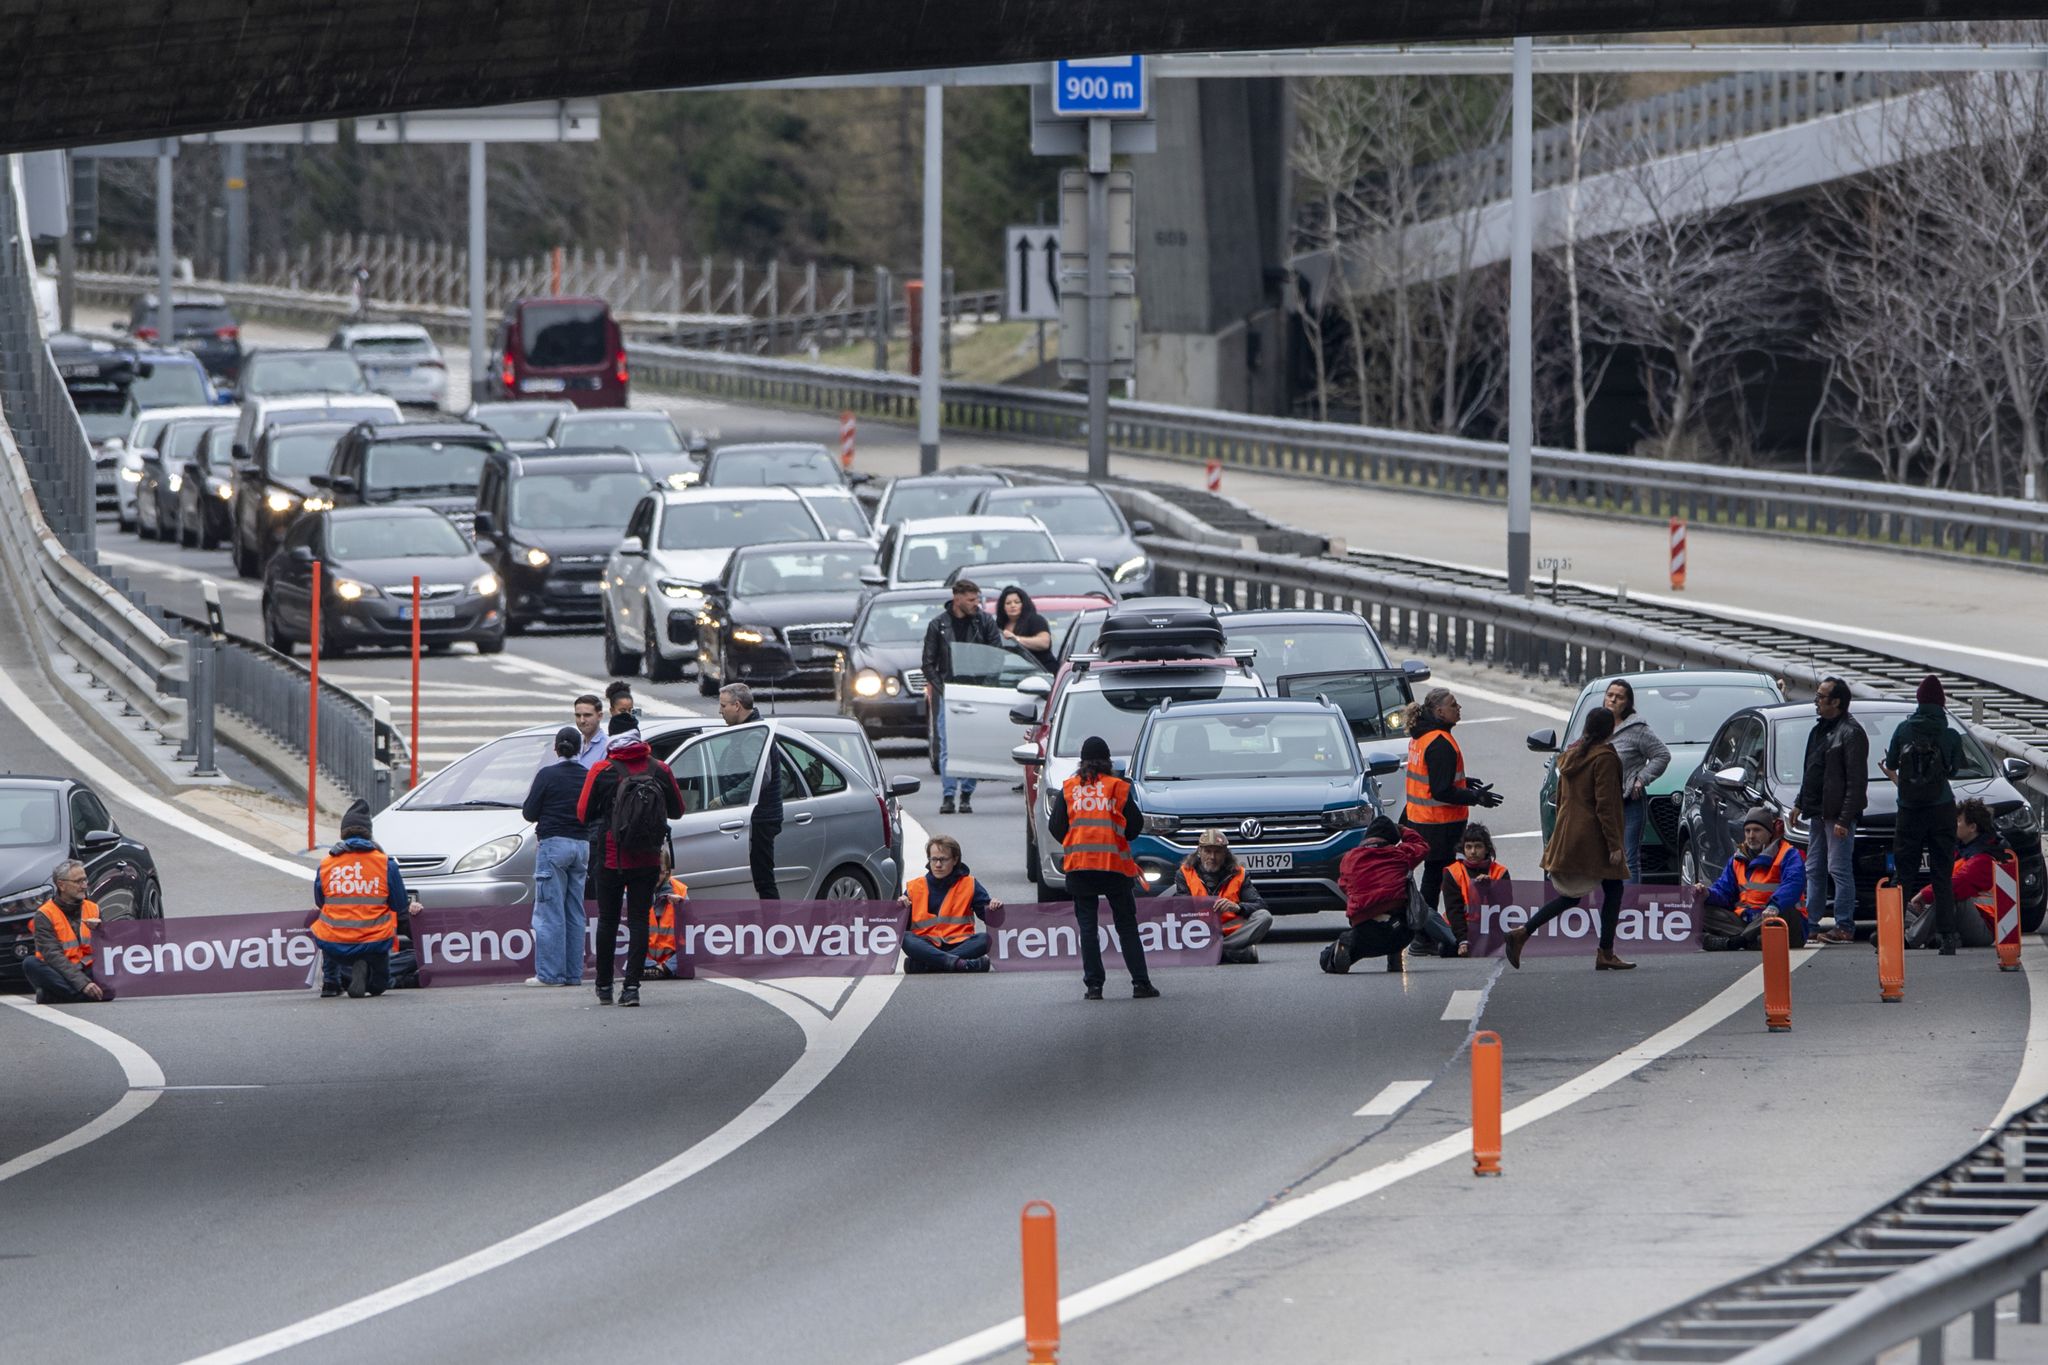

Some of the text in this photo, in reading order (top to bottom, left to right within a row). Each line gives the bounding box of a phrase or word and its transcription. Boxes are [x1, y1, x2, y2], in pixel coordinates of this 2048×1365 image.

[1066, 76, 1134, 100] 900 m
[1072, 781, 1105, 799] act
[330, 861, 363, 880] act
[1266, 854, 1291, 868] 879
[329, 877, 380, 895] now!
[685, 917, 897, 956] renovate
[103, 928, 315, 976] renovate
